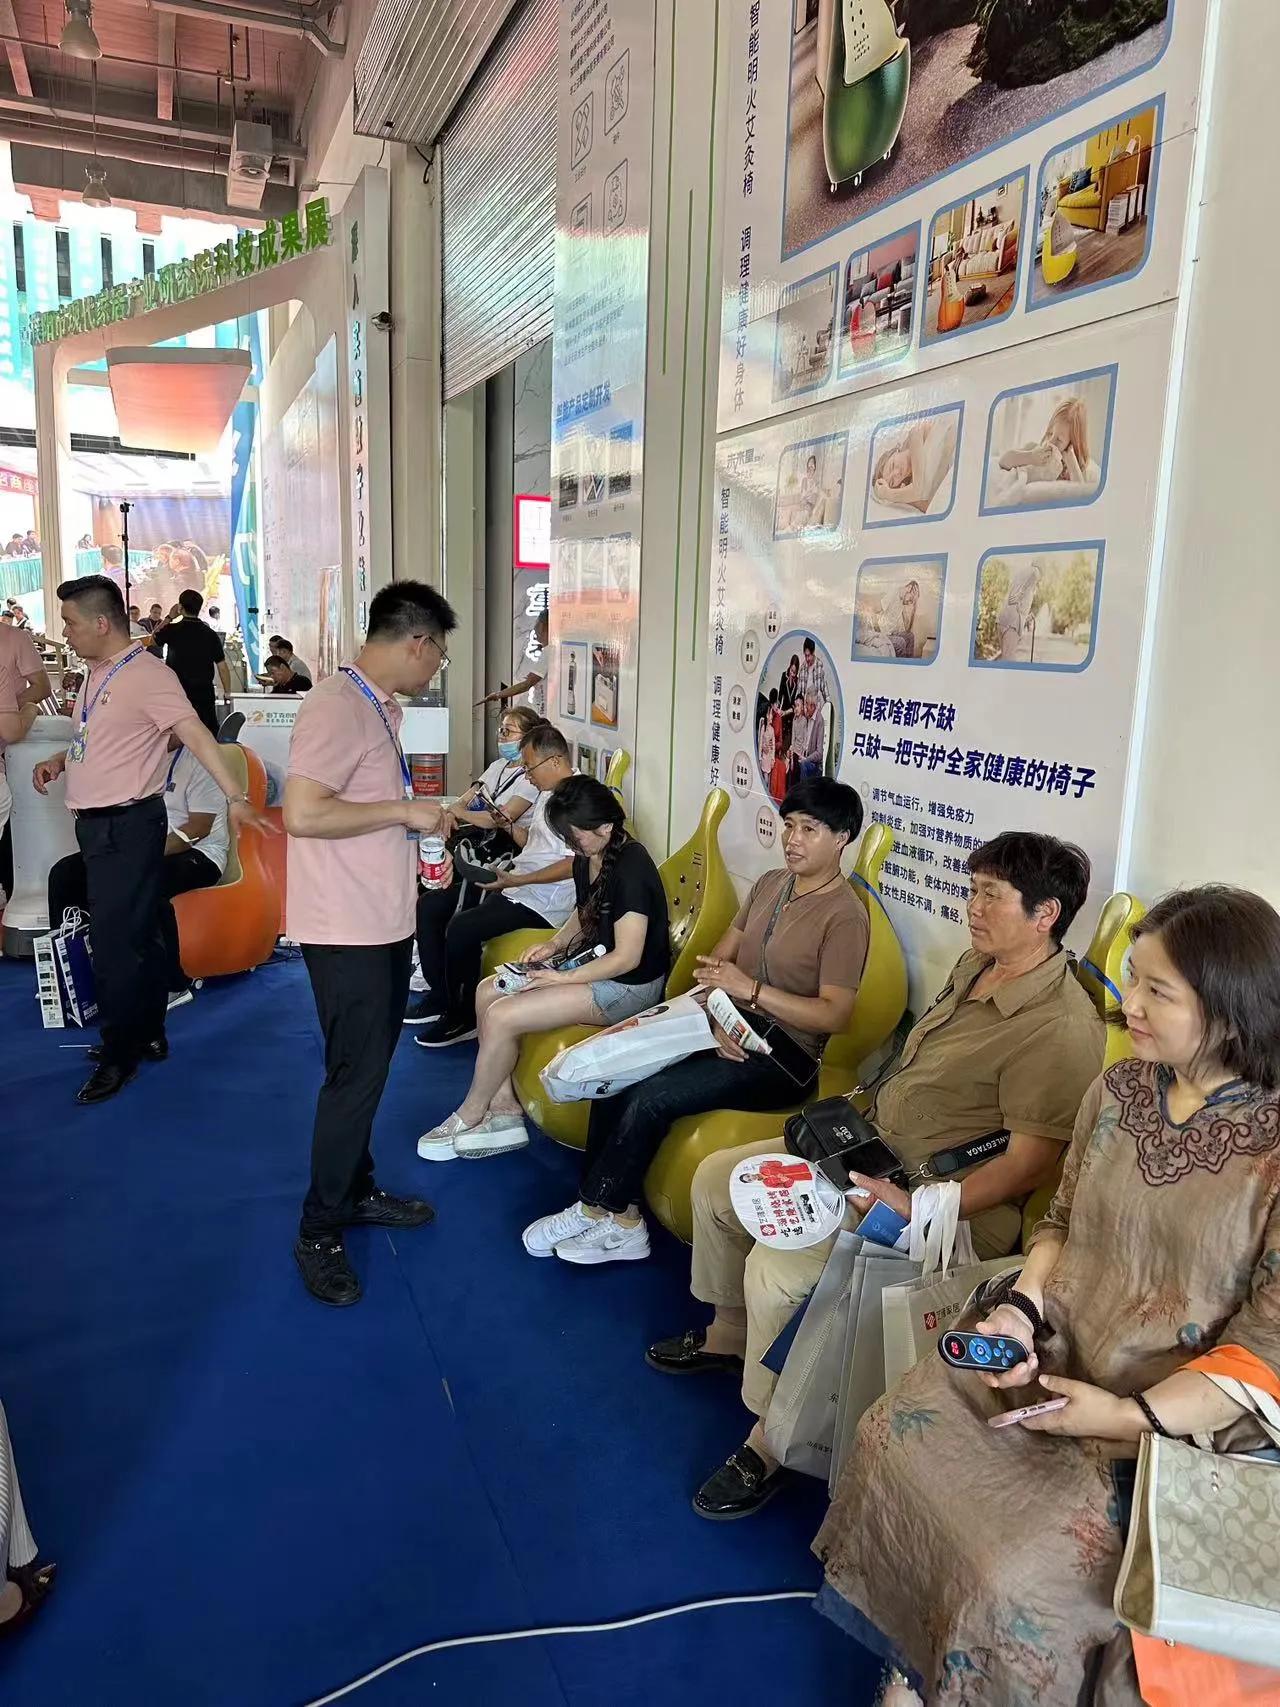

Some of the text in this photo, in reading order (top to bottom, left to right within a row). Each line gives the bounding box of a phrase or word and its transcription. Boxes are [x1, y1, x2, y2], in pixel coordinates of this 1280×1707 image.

[858, 694, 956, 732] 咱家啥都不缺
[851, 732, 1097, 799] 只缺一把守护全家健康的椅子
[871, 810, 990, 851] 抑制炎症，加强对营养物质的
